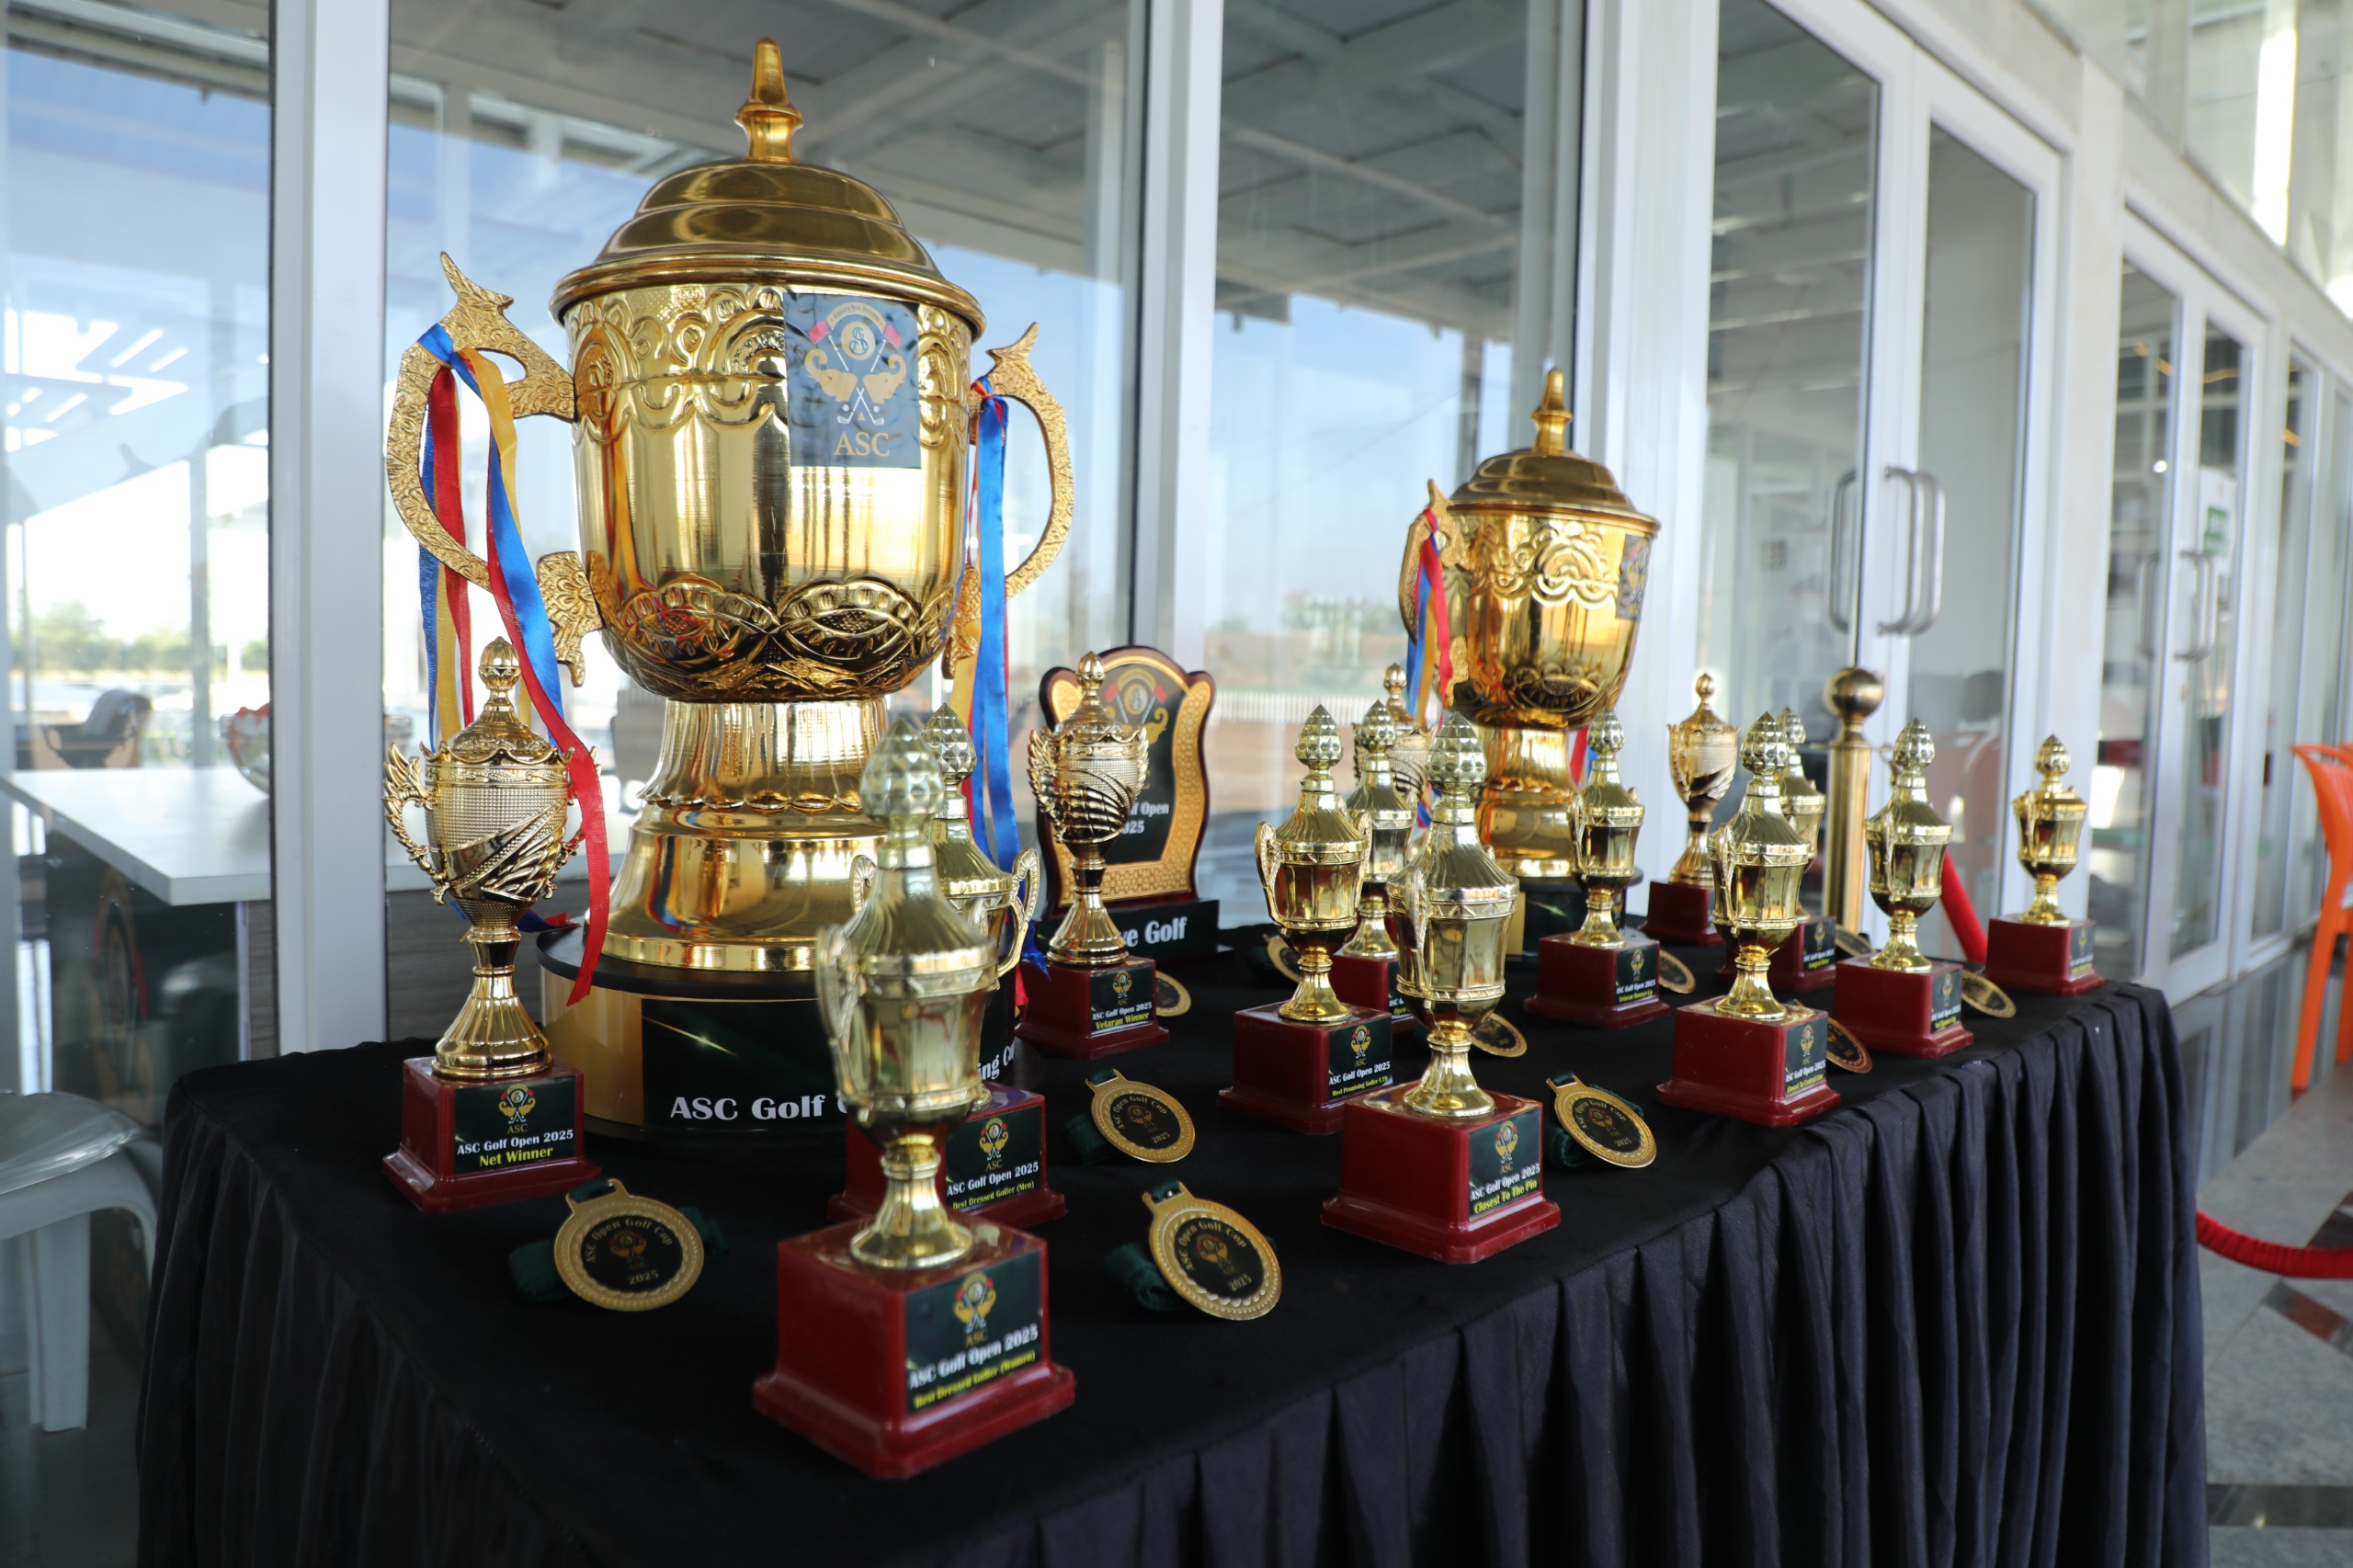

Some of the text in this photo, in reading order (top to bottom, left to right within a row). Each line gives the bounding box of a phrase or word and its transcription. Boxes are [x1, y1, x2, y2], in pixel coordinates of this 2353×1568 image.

[833, 431, 890, 457] ASC
[1141, 801, 1169, 818] Open
[1144, 916, 1188, 945] Golf
[1105, 1009, 1119, 1018] Golf
[1120, 1006, 1135, 1016] Open
[1136, 1002, 1153, 1011] 2025
[1125, 1013, 1150, 1024] Winner
[1355, 1058, 1366, 1068] ASC
[1794, 1068, 1803, 1079] Golf
[1803, 1064, 1814, 1075] Open
[1814, 1059, 1825, 1072] 2025
[1329, 1061, 1391, 1086] ASC Golf Open 2025
[1344, 1083, 1366, 1094] Promising
[669, 1096, 738, 1120] ASC
[751, 1095, 825, 1120] Golf
[1112, 1095, 1168, 1129] ASC Open Golf Cup
[1575, 1101, 1590, 1114] Open
[507, 1123, 528, 1134] ASC
[1152, 1131, 1171, 1143] 2025
[457, 1130, 574, 1155] ASC Golf Open 2025
[1615, 1137, 1632, 1147] 2025
[480, 1147, 553, 1167] Net Winner
[985, 1159, 1003, 1172] ASC
[1500, 1162, 1514, 1175] ASC
[947, 1161, 1039, 1197] ASC Golf Open 2025
[1471, 1162, 1540, 1202] ASC Golf Open 2025
[952, 1180, 1035, 1210] Best Dressed Golfer (Men)
[1473, 1178, 1538, 1214] Closest To The Pin
[585, 1217, 673, 1264] ASC Open Golf Cup
[1178, 1221, 1246, 1270] ASC Open Golf Cup
[628, 1269, 660, 1286] 2025
[1228, 1273, 1252, 1291] 2025
[966, 1329, 989, 1347] ASC
[908, 1323, 1039, 1390] ASC Golf Open 2025
[936, 1377, 972, 1400] Dressed
